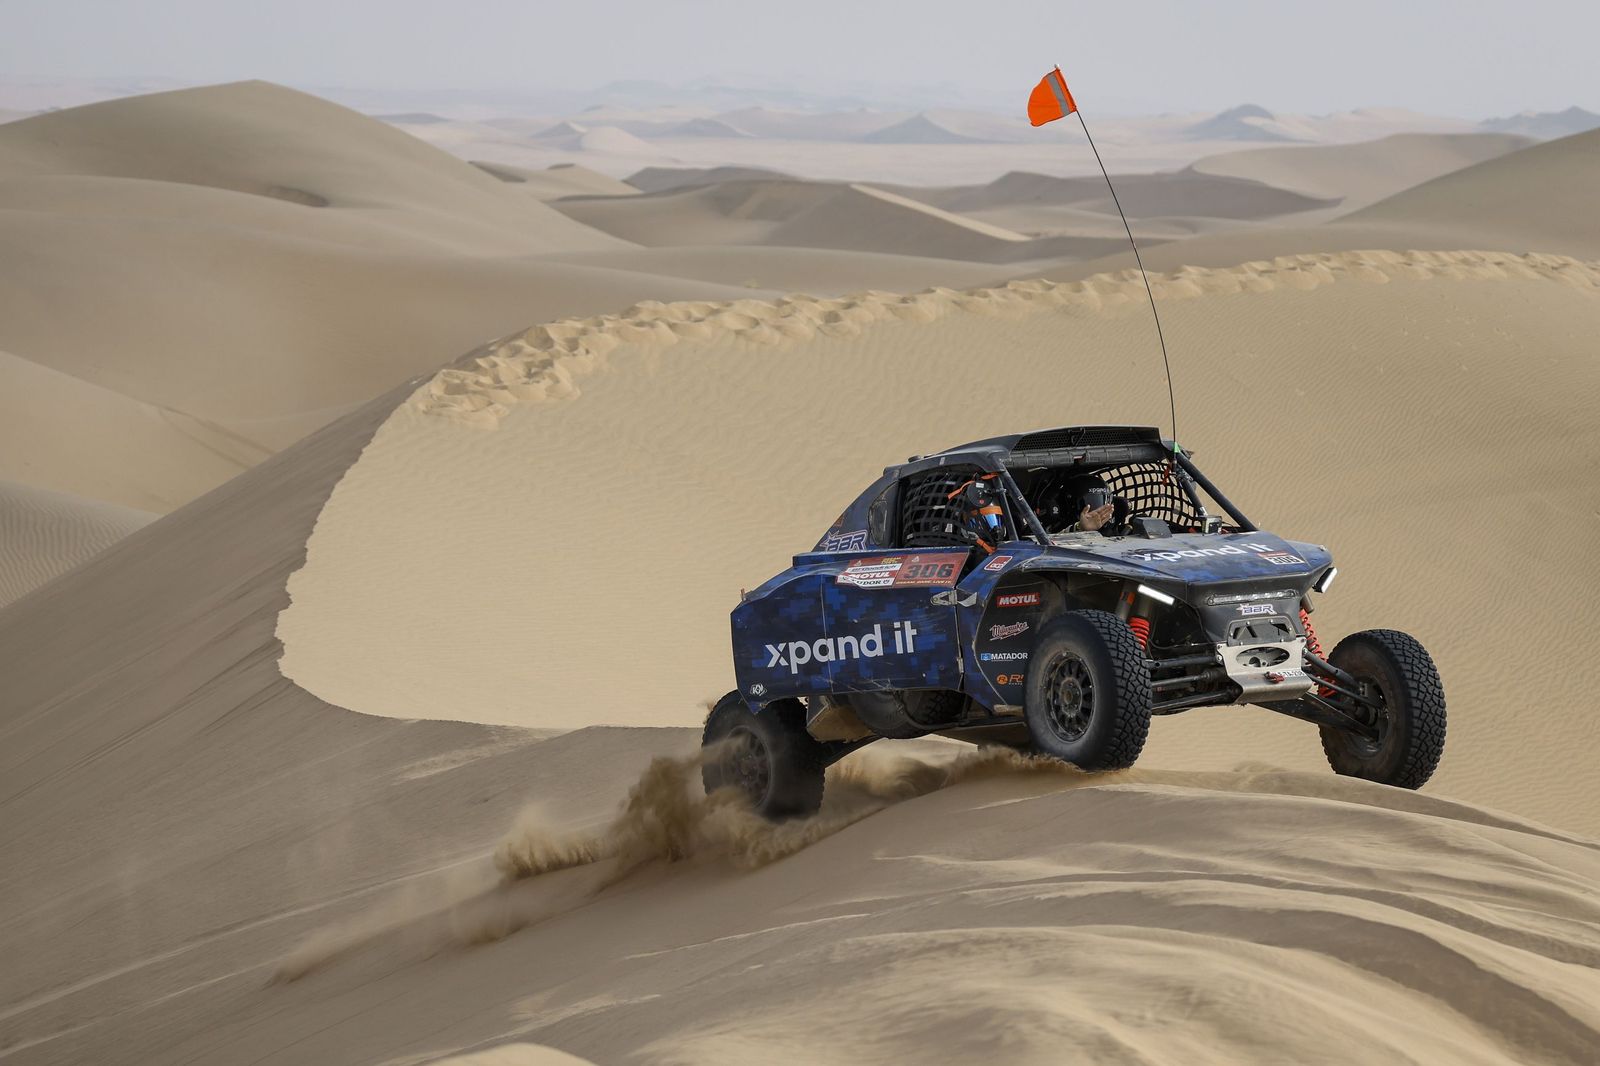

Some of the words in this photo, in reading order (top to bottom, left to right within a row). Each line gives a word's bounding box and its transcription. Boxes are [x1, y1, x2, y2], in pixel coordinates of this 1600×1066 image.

[826, 530, 868, 552] BBR
[1132, 544, 1248, 562] xpand
[1241, 543, 1274, 552] it
[903, 563, 955, 579] 306
[999, 594, 1038, 605] MOTUL
[1241, 604, 1278, 616] BBR
[765, 623, 884, 675] xpand
[893, 620, 918, 655] it
[991, 652, 1029, 660] MATADOR
